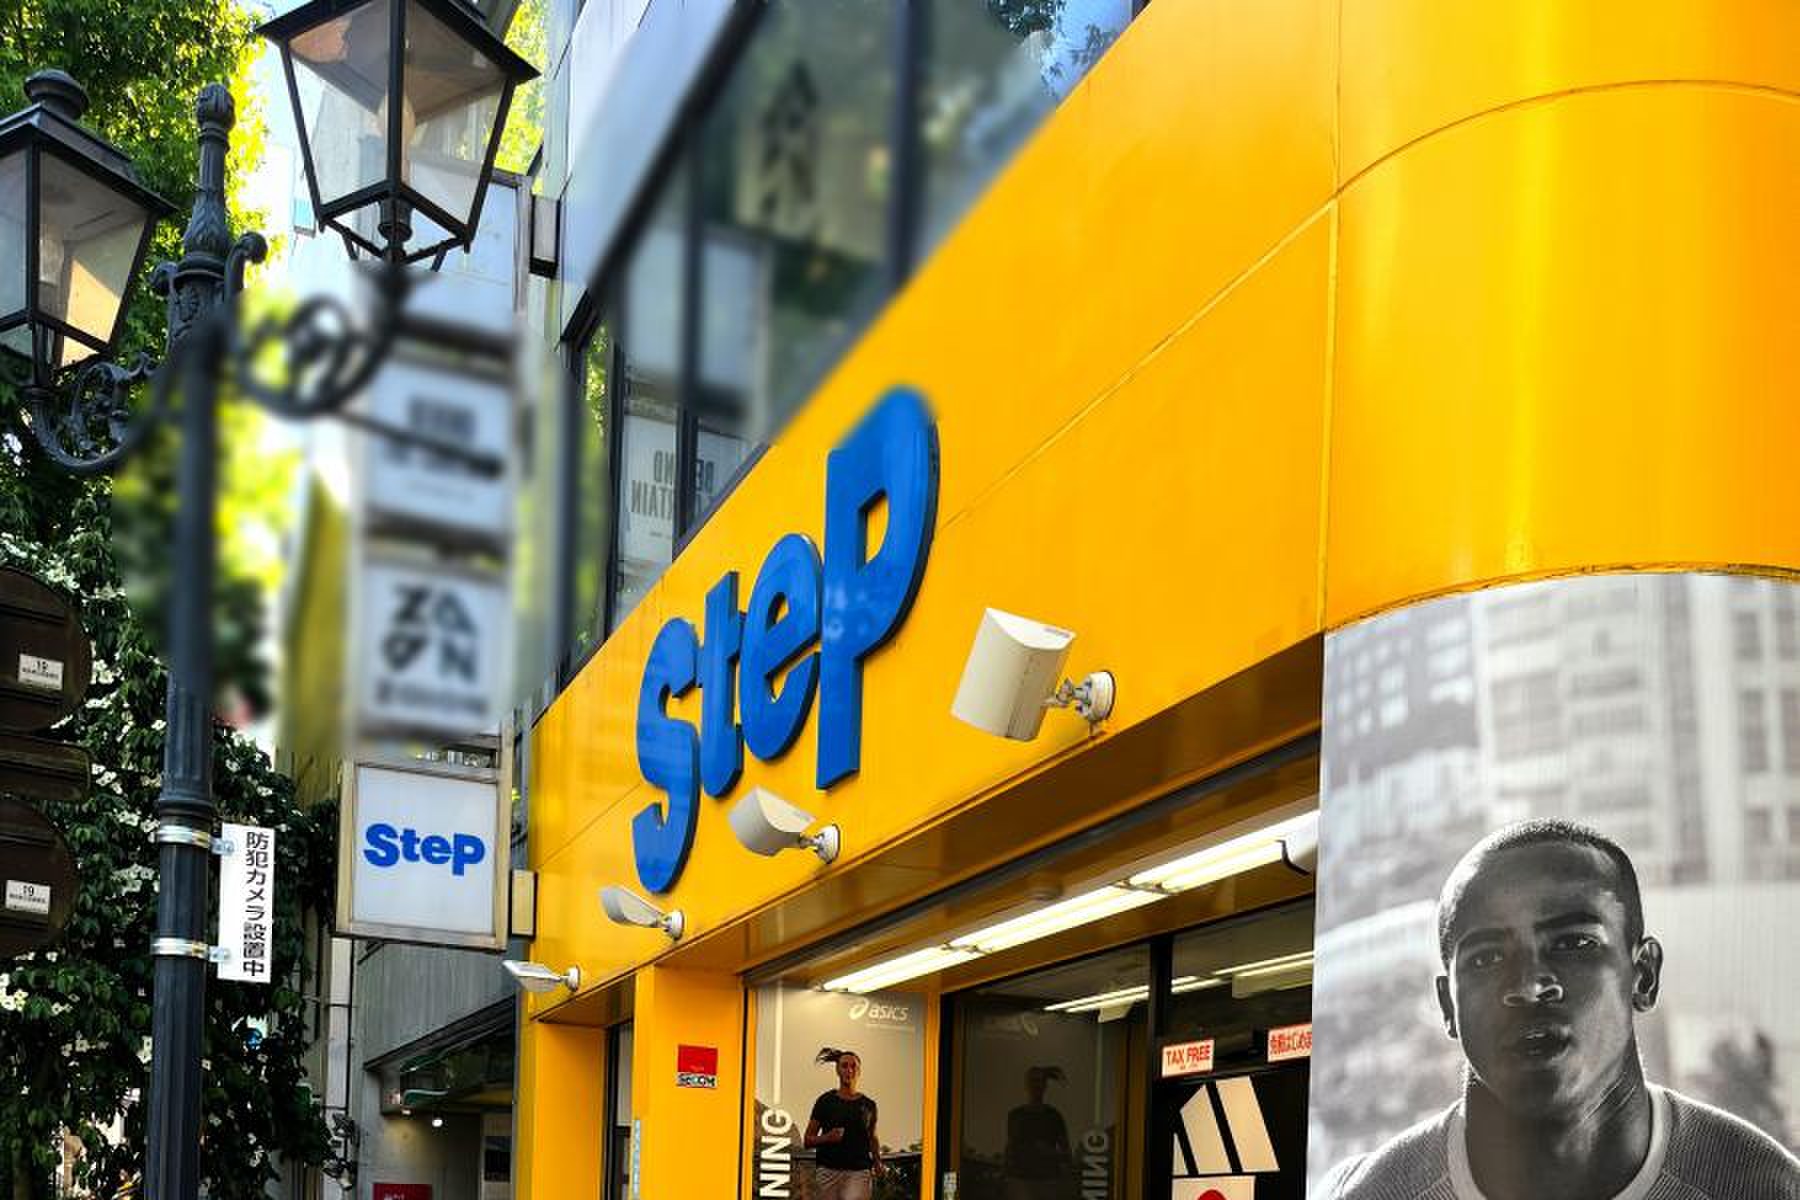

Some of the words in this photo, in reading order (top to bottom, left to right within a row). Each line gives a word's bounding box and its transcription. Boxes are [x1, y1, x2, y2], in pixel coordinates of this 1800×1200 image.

[631, 384, 941, 893] Step
[364, 823, 486, 876] Step
[243, 831, 270, 977] 防犯カメラ設置中
[1166, 1049, 1185, 1067] TAX
[1187, 1044, 1211, 1064] FREE
